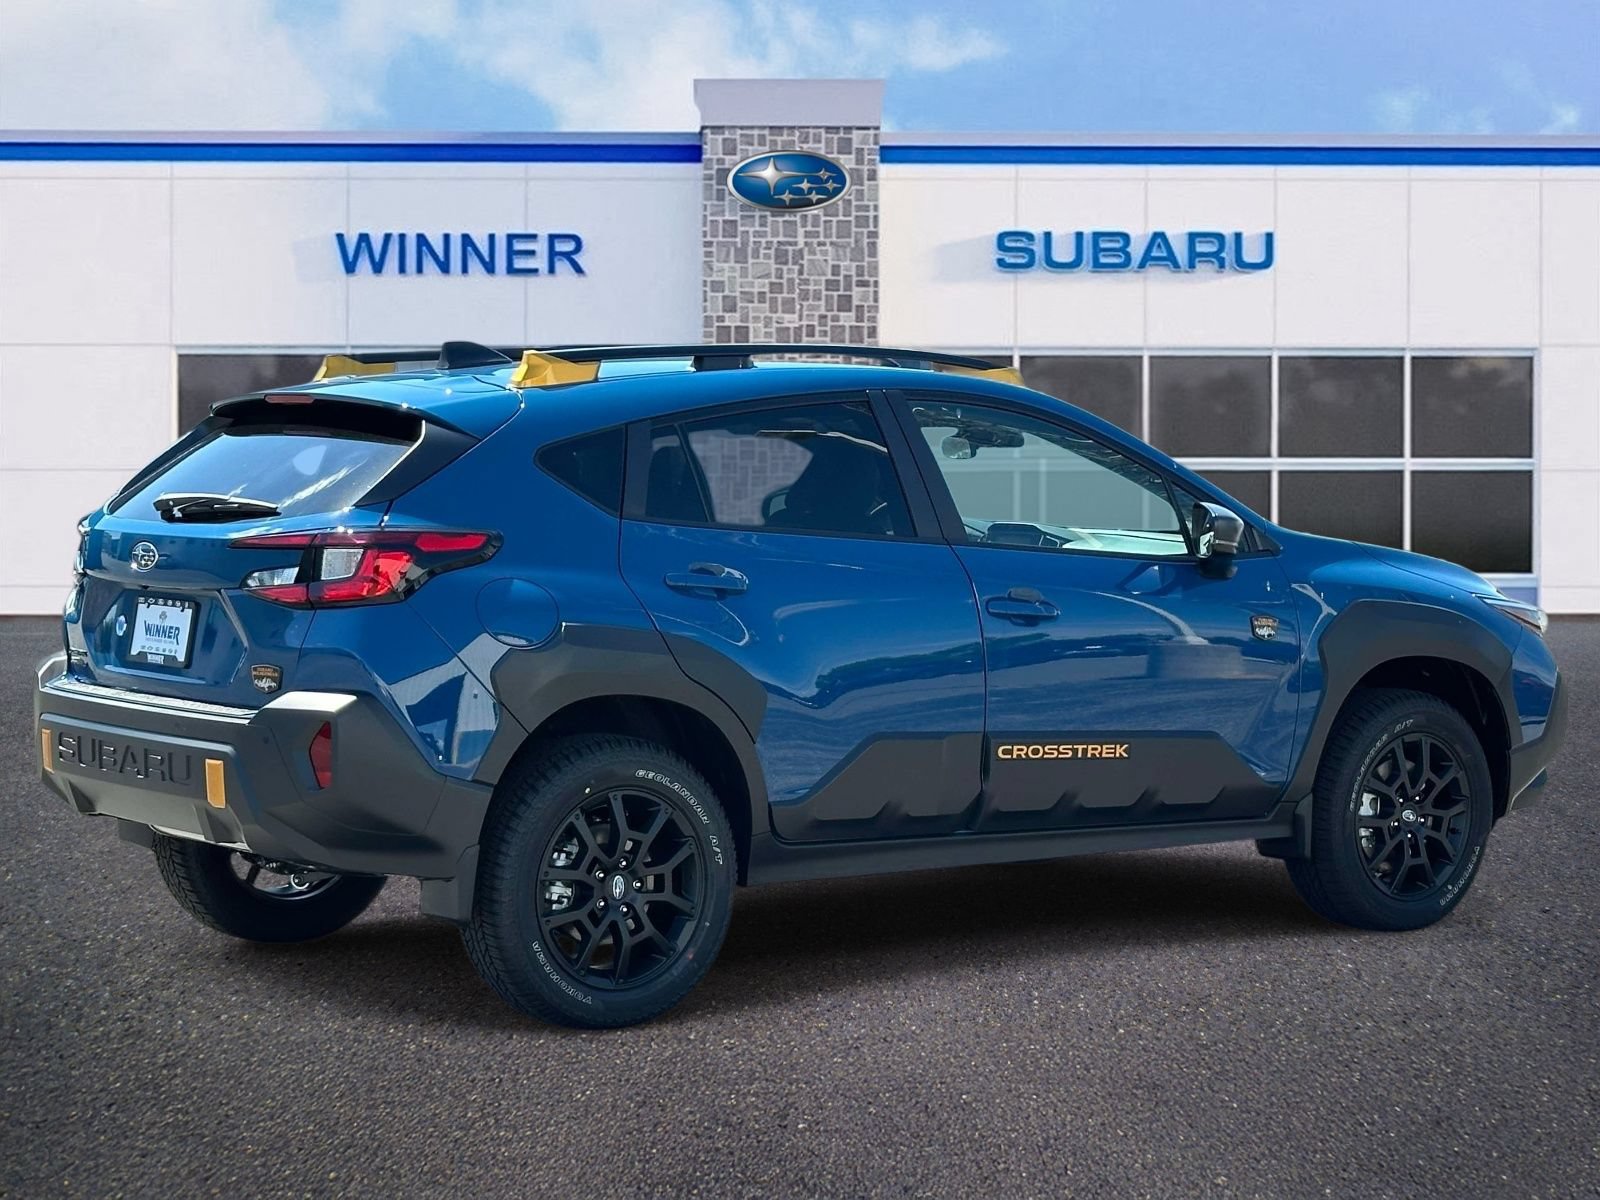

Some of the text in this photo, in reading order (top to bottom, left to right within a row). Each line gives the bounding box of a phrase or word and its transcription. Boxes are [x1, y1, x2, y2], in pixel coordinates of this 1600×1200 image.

[335, 232, 587, 276] WINNER
[996, 230, 1275, 272] SUBARU
[143, 619, 181, 646] WINNER
[58, 731, 192, 786] SUBARU
[997, 744, 1129, 759] CROSSTREK
[635, 769, 723, 865] GEOLANDAR A/T
